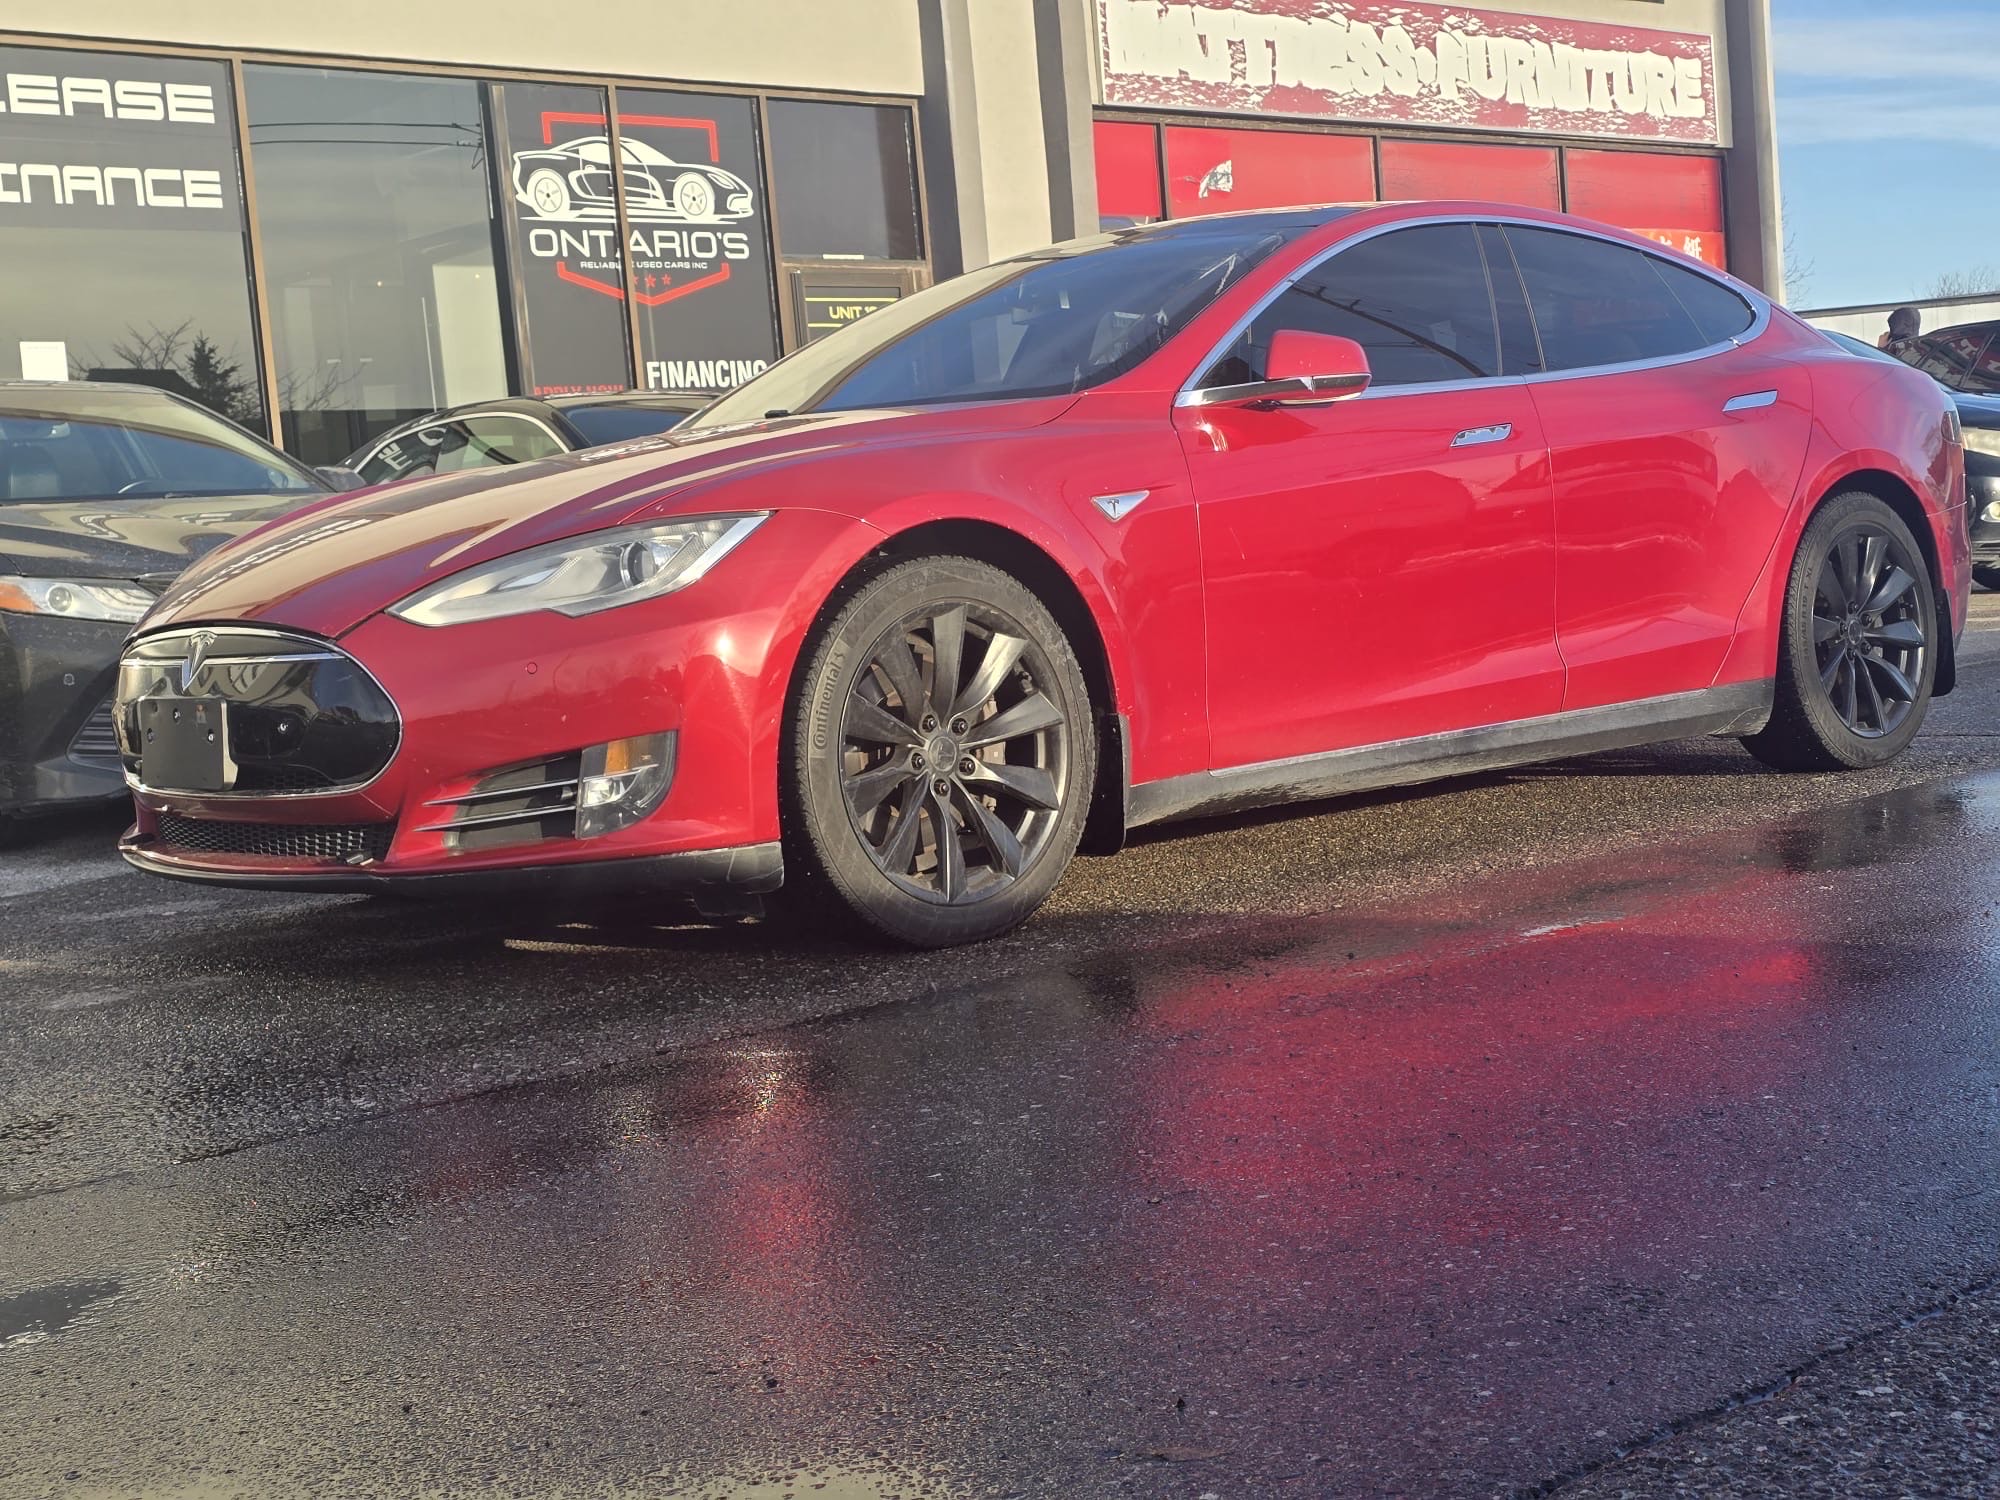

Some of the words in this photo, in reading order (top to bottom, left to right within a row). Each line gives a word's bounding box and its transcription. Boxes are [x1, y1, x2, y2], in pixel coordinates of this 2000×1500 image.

[0, 73, 215, 124] EASE
[580, 261, 635, 270] RELIABL
[636, 261, 663, 270] USED
[664, 261, 690, 270] CARS
[691, 262, 708, 270] INC
[828, 306, 862, 320] UNIT
[813, 661, 842, 749] Continental
